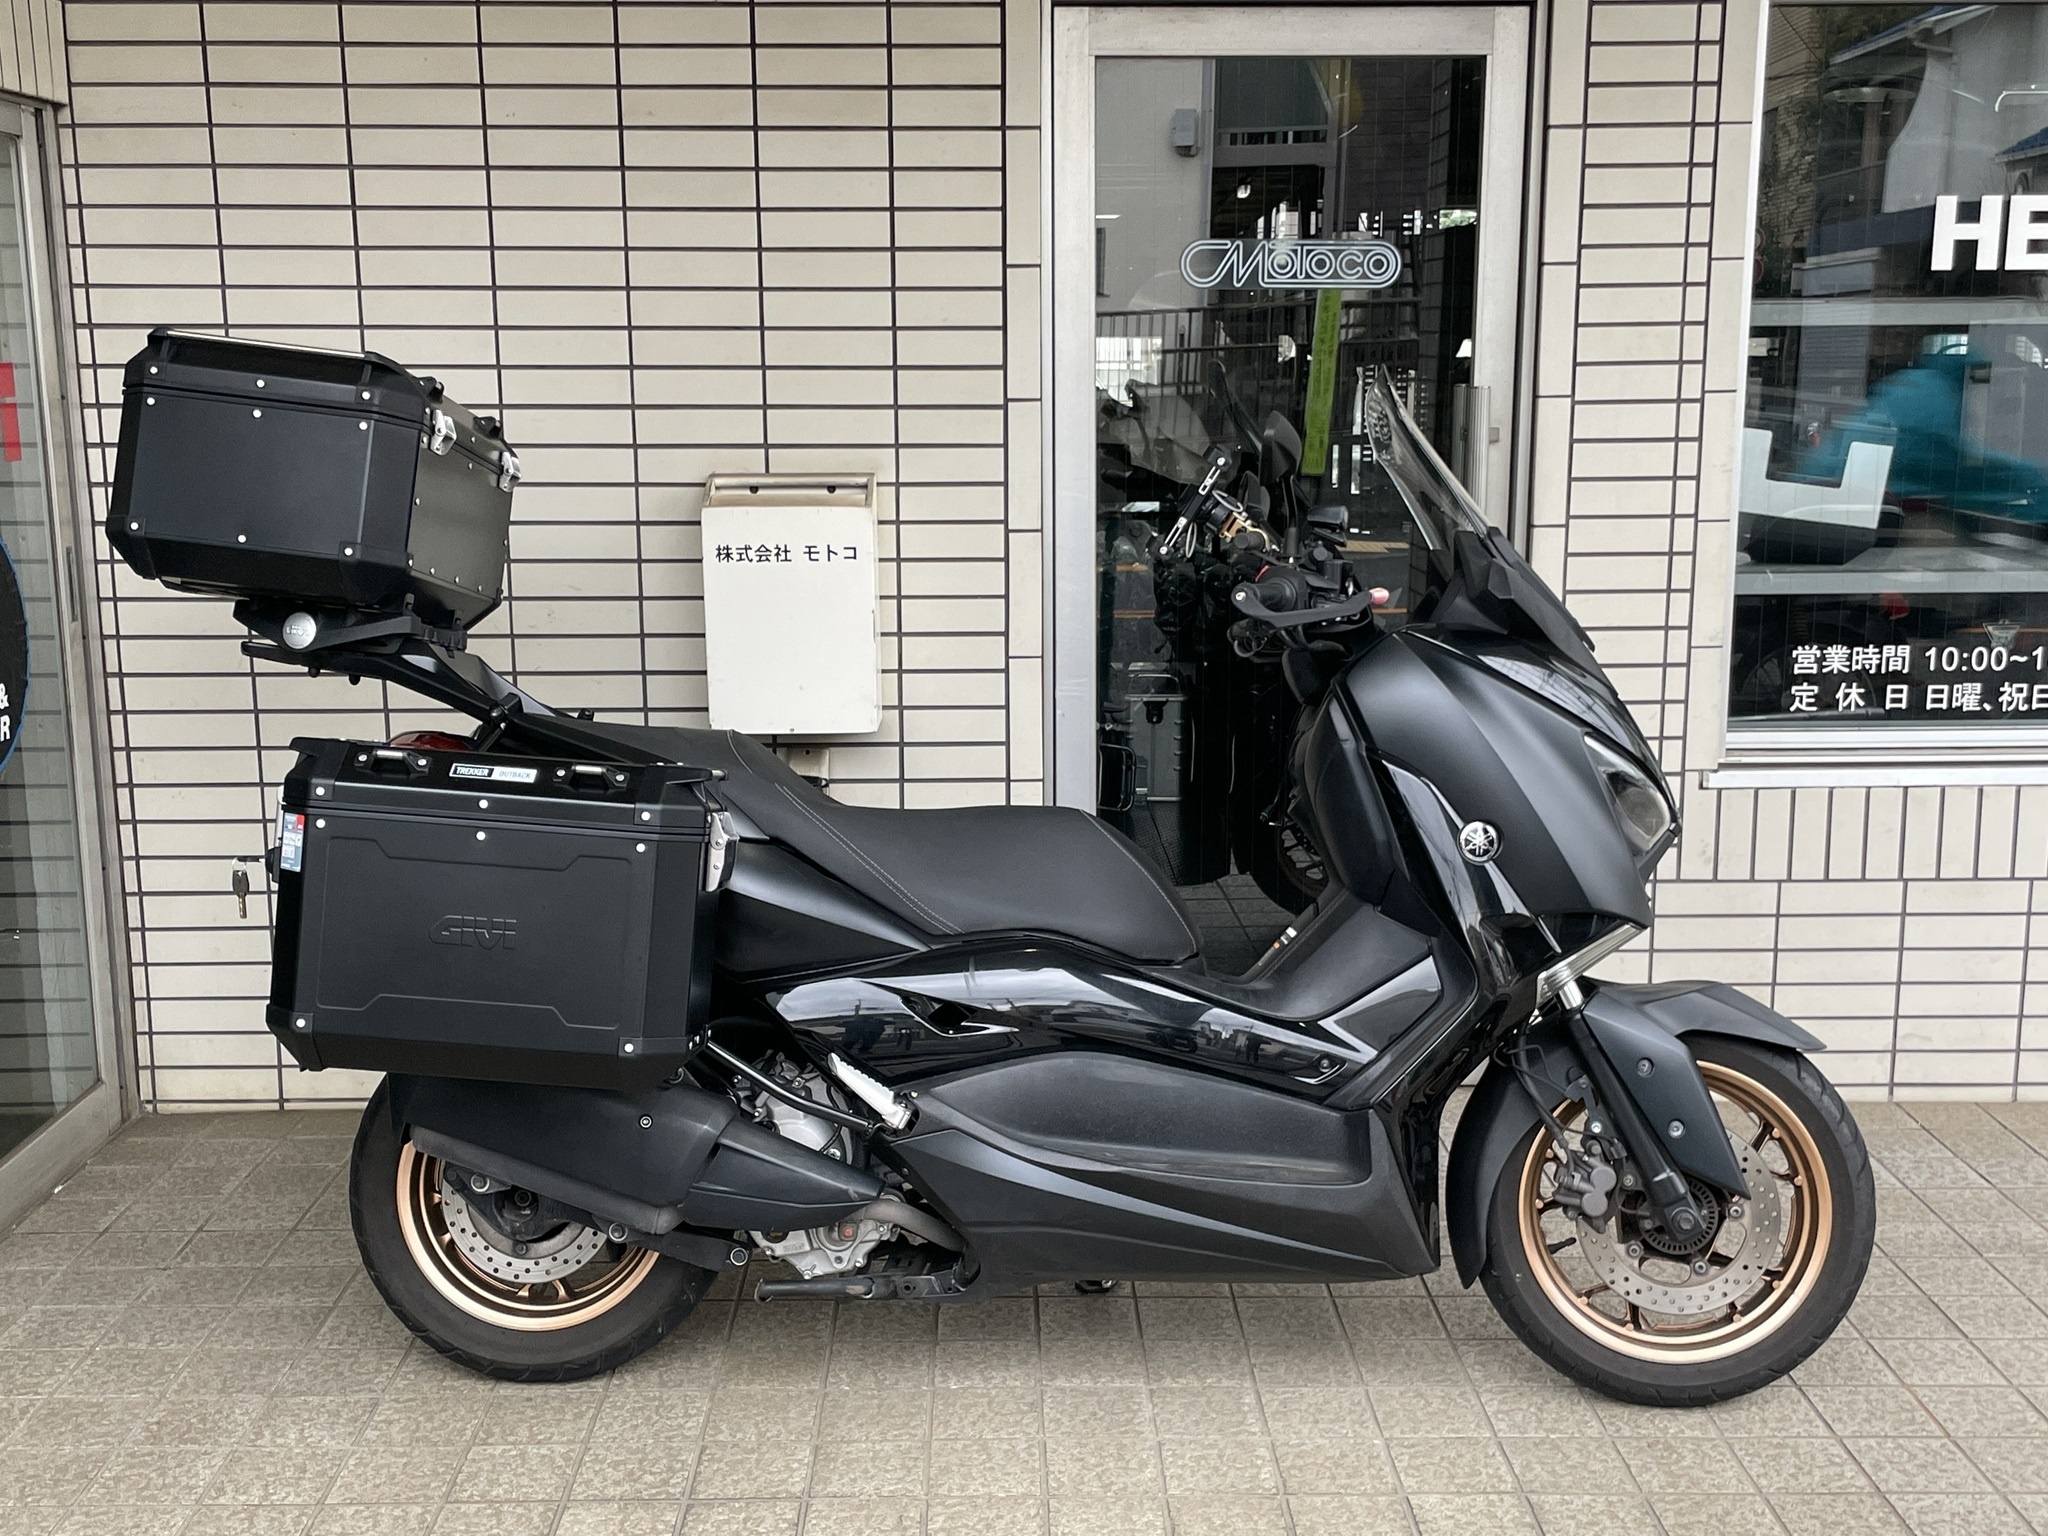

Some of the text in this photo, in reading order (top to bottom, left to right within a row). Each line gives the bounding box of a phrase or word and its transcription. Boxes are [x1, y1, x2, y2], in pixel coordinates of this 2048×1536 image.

[1931, 195, 2048, 271] HE
[715, 544, 857, 563] 株式会社 モトコ
[1792, 644, 1910, 675] 営業時間
[456, 766, 532, 779] TREKKER OUTBACK
[429, 914, 517, 950] GIVI
